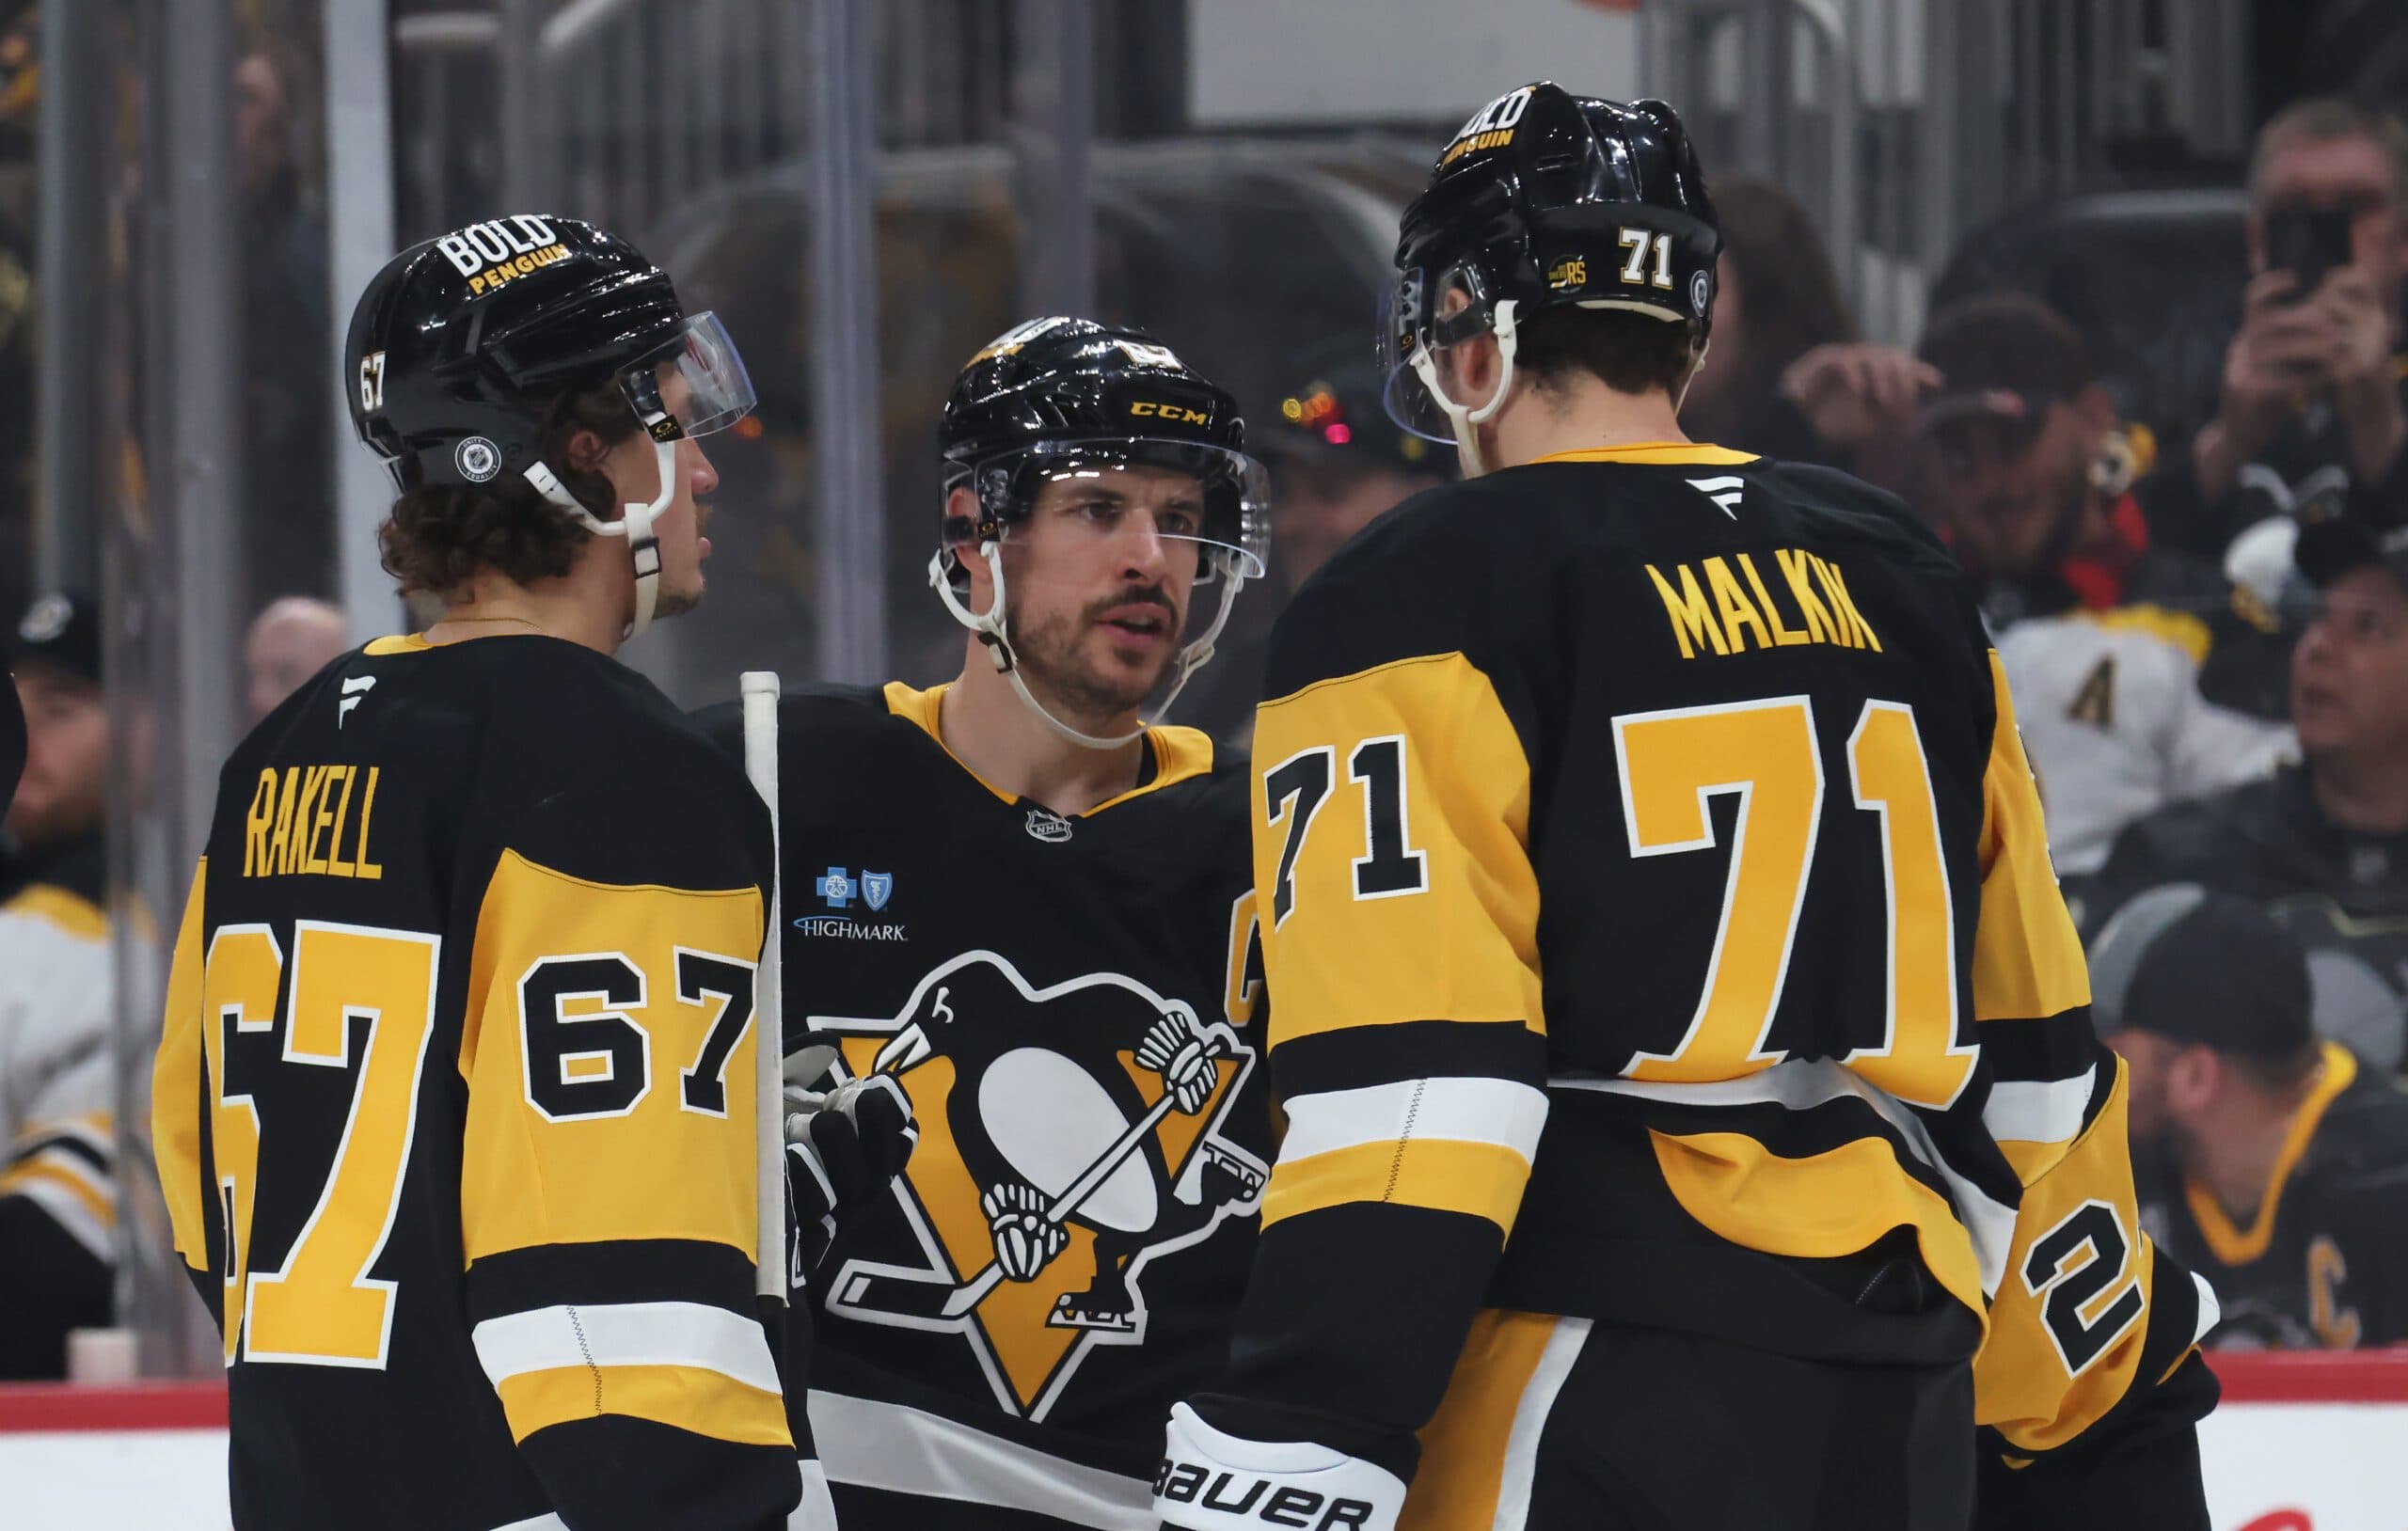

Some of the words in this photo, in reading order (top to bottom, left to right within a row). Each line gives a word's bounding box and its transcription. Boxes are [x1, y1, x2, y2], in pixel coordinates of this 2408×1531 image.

[437, 214, 557, 277] BOLD
[469, 244, 572, 294] PENGUIN
[1618, 227, 1672, 290] 71
[360, 351, 386, 411] 67
[1130, 402, 1208, 425] CCM
[1644, 549, 1883, 658] MALKIN
[2065, 653, 2115, 729] A
[243, 765, 383, 879] RAKELL
[1037, 823, 1063, 835] NHL
[1263, 734, 1430, 933] 71
[804, 920, 907, 941] HIGHMARK
[1611, 694, 1980, 1111] 71
[517, 944, 757, 1124] 67
[204, 919, 442, 1370] 67
[2019, 1197, 2147, 1381] 2
[2307, 1235, 2361, 1349] C
